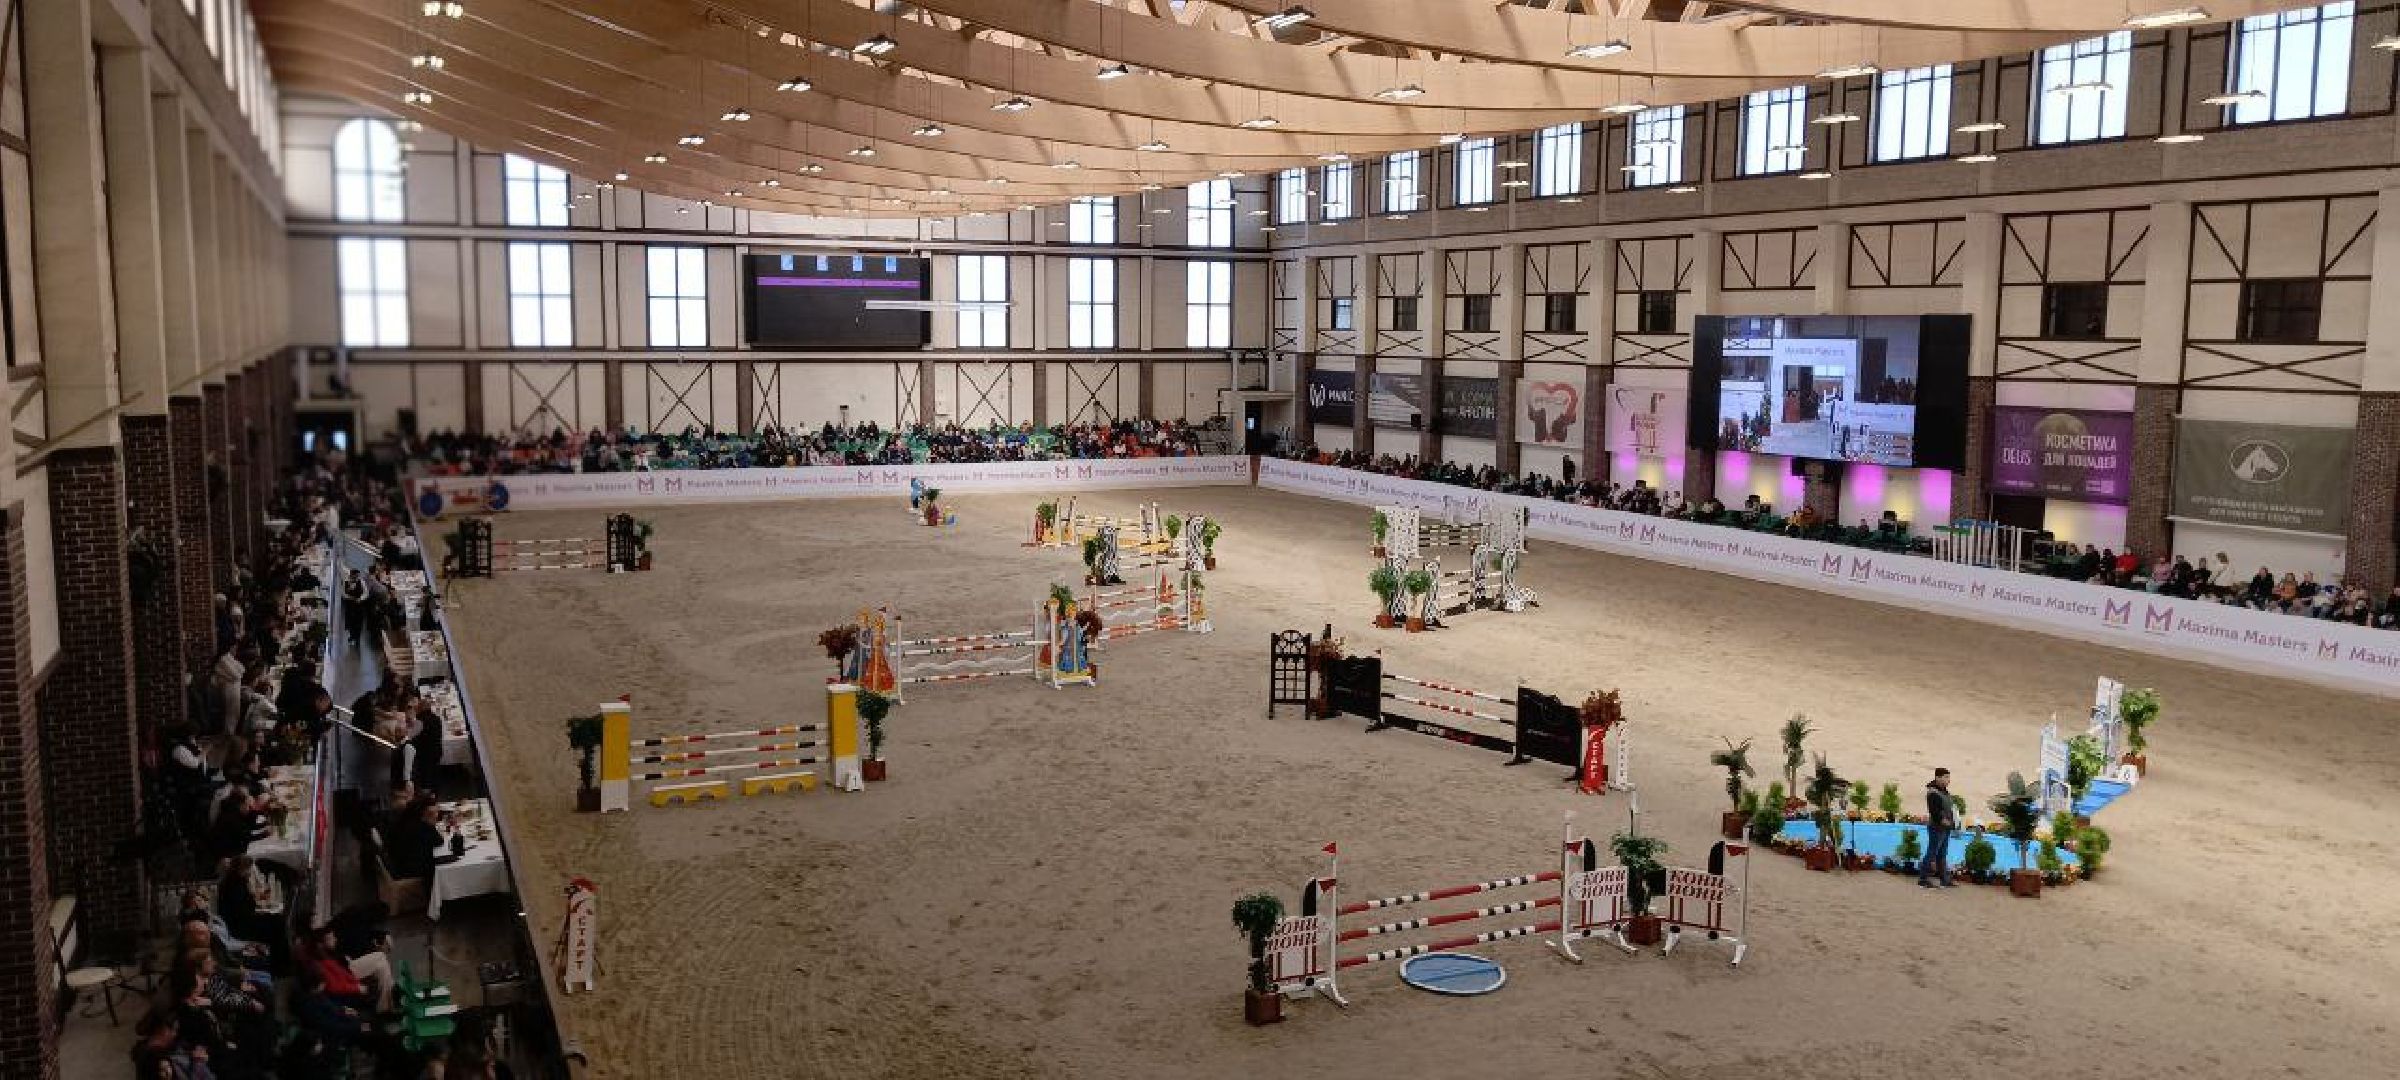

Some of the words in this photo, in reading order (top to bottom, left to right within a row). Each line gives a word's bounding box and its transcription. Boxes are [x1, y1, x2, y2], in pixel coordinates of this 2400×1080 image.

[2046, 434, 2117, 451] КОСМЕТИКА
[2003, 447, 2031, 466] DEUS
[2043, 452, 2065, 466] ДЛЯ
[1920, 575, 1966, 594] Masters
[1992, 585, 2043, 607] Maxima
[2044, 597, 2098, 617] Masters
[2104, 597, 2131, 625] M
[2145, 602, 2174, 632] M
[2177, 616, 2239, 641] Maxima
[2243, 629, 2309, 653] Masters
[1583, 870, 1626, 886] КОНИ
[1670, 869, 1724, 889] КОНИ
[1581, 884, 1625, 899] ПОНИ
[1669, 883, 1724, 902] ПОНИ
[576, 915, 587, 971] СТАРТ
